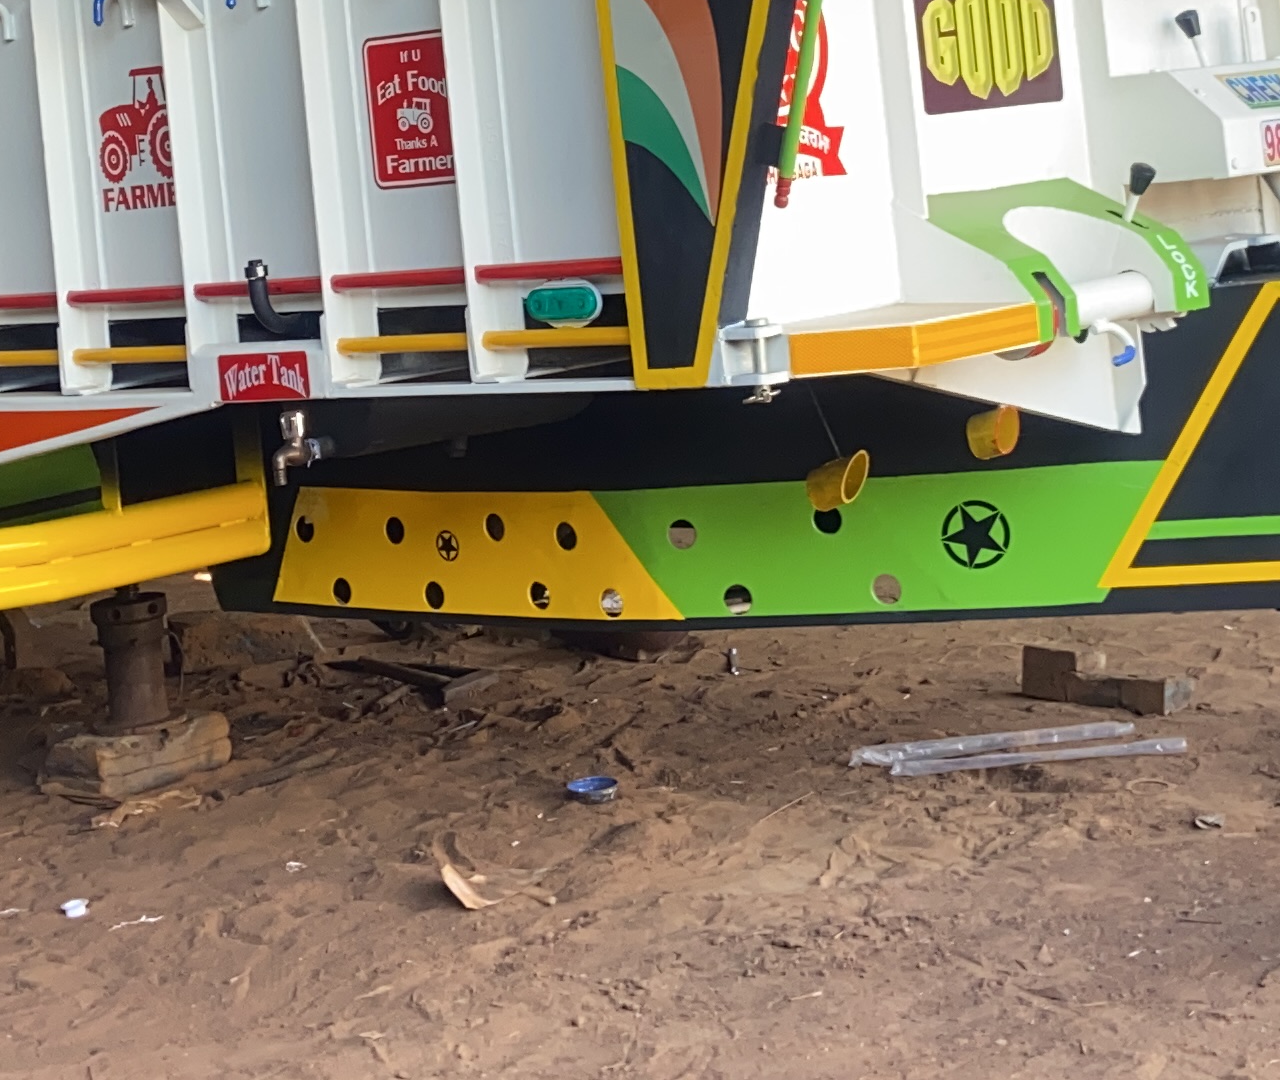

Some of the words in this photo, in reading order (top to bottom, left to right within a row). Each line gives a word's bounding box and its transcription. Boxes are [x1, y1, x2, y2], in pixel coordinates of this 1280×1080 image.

[411, 48, 421, 62] U
[376, 73, 402, 107] Eat
[406, 69, 447, 99] Food
[394, 137, 428, 151] Thanks
[429, 134, 439, 148] A
[385, 153, 454, 175] Farmer
[103, 182, 176, 213] FARME
[1156, 234, 1199, 298] LOCK
[224, 362, 267, 401] Water
[267, 354, 306, 399] Tank
